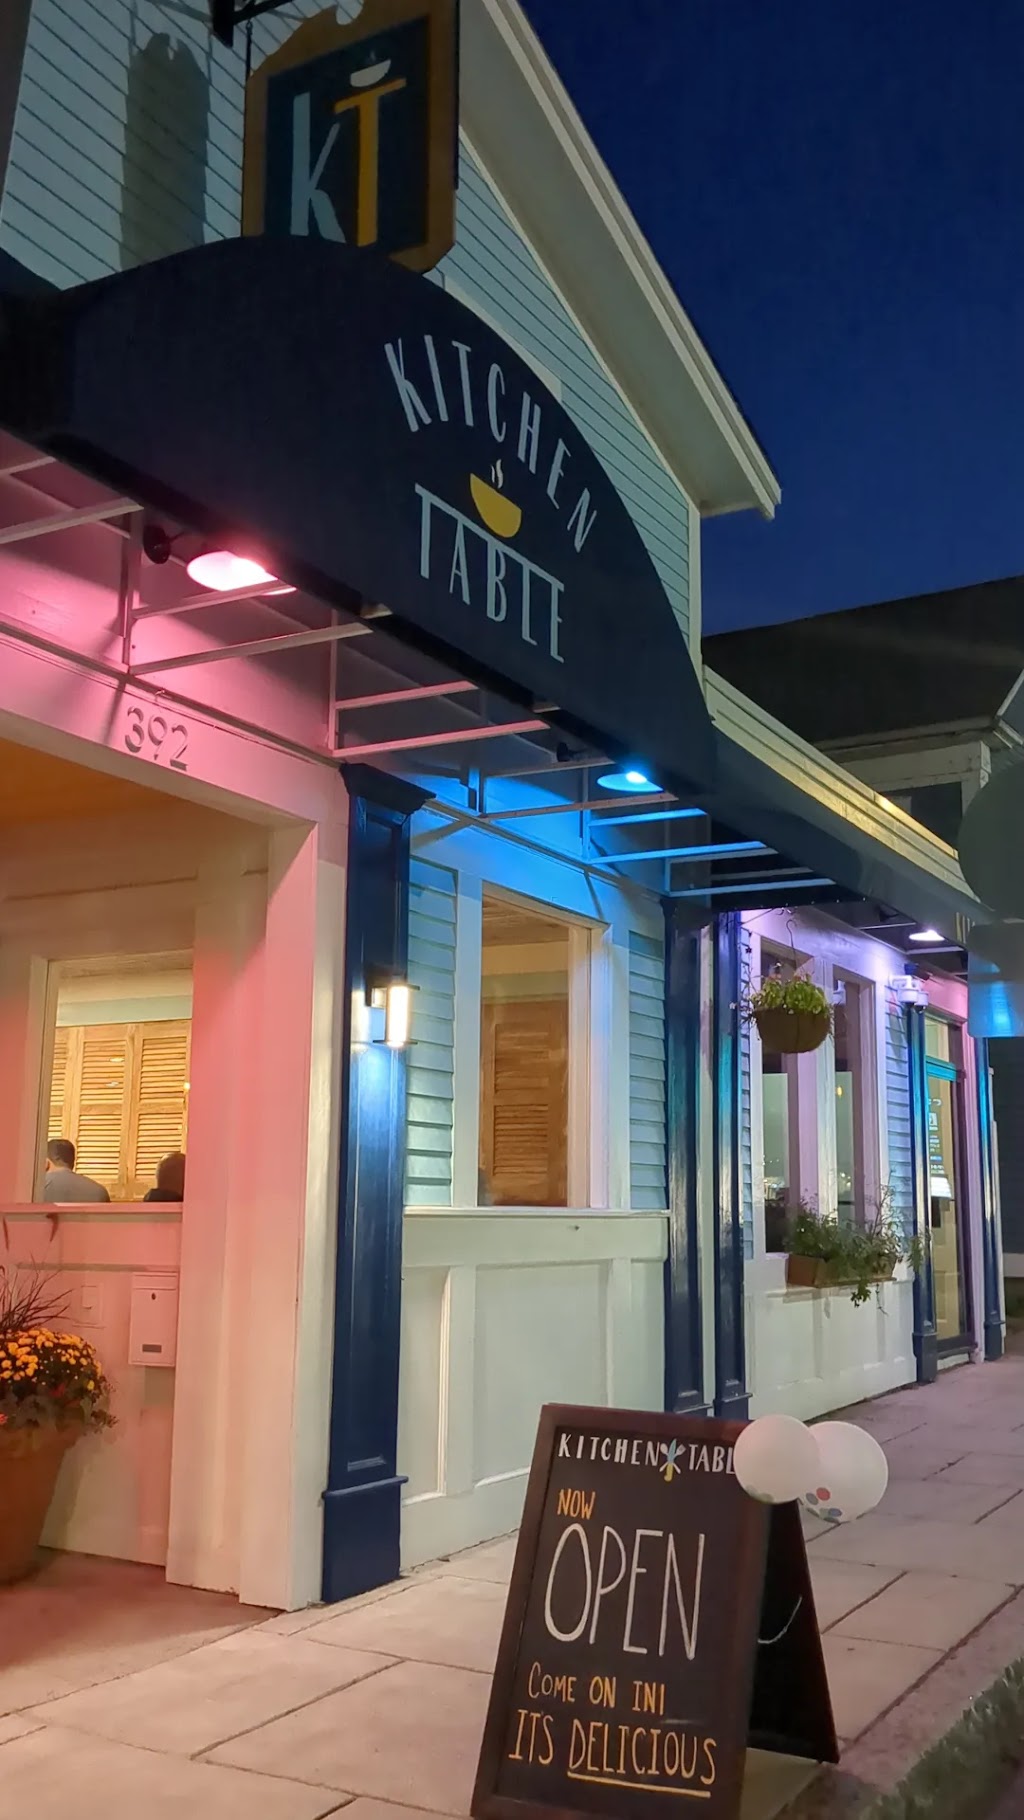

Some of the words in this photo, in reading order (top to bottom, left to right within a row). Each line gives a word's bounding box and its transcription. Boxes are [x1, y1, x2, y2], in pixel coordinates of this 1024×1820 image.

[290, 77, 407, 247] KT
[384, 334, 598, 553] KITCHEN
[414, 482, 565, 664] TABLE
[124, 706, 189, 772] 392
[557, 1432, 661, 1467] KITCHEN
[688, 1443, 736, 1475] TABL
[557, 1488, 596, 1520] NOW
[544, 1522, 705, 1660] OPEN
[589, 1676, 616, 1708] ON
[568, 1718, 717, 1785] DELICIOUS
